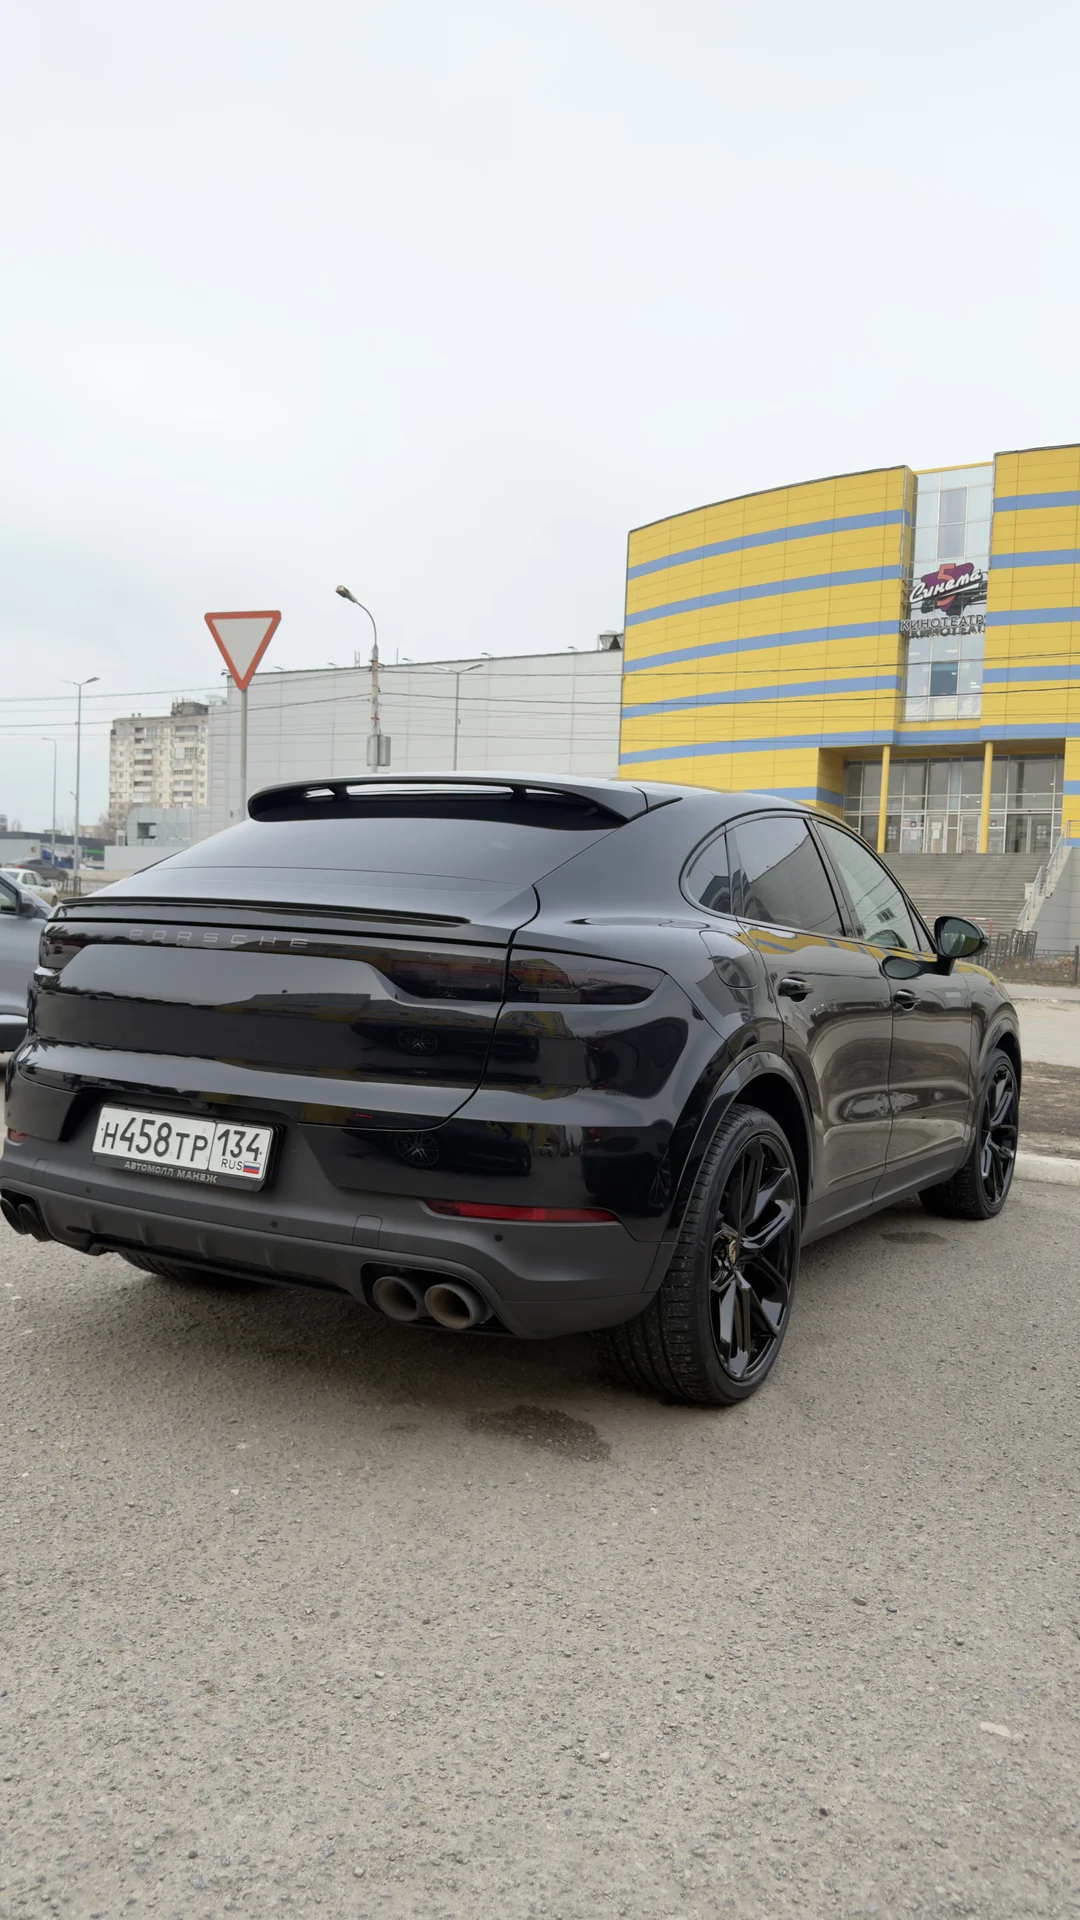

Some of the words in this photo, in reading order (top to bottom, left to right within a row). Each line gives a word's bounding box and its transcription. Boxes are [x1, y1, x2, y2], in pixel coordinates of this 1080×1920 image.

[909, 568, 982, 603] Синема
[937, 563, 956, 607] 5
[900, 614, 985, 632] КИНОТЕАТР
[129, 929, 309, 948] PORSCHE
[217, 1129, 261, 1161] 134
[124, 1160, 175, 1177] АВТОМОЛЛ
[176, 1170, 217, 1184] МАНЕЖ
[221, 1158, 243, 1171] RUS
